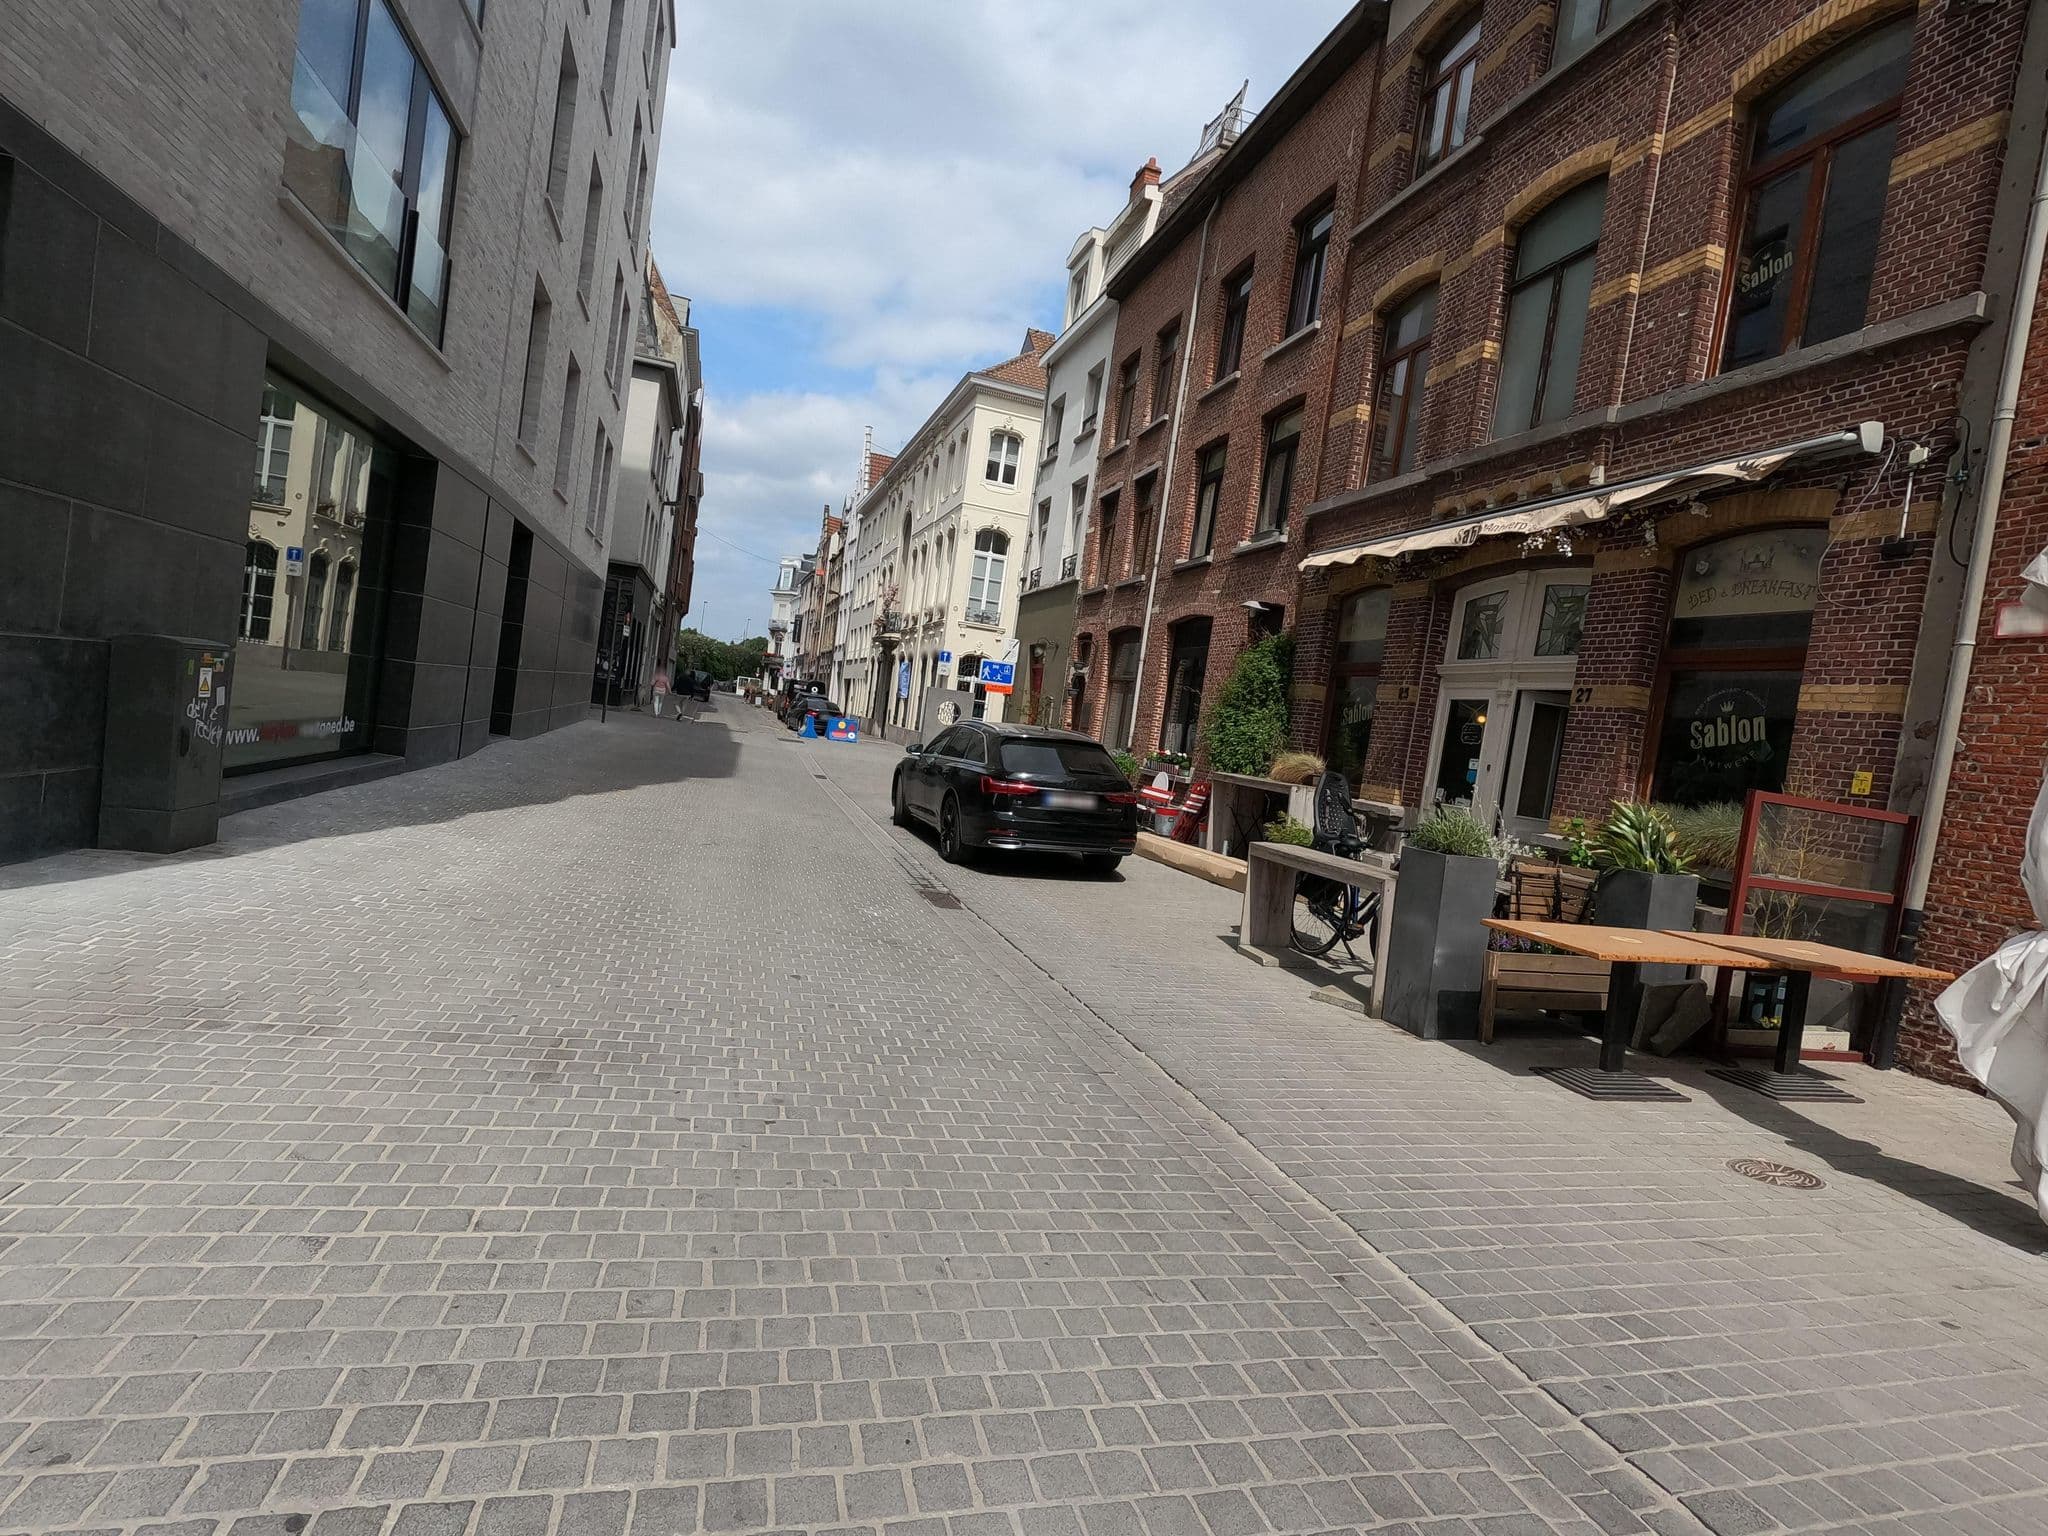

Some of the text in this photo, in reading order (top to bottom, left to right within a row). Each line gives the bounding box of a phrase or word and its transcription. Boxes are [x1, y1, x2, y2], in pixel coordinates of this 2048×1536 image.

[1741, 251, 1793, 293] Sablon
[1575, 687, 1593, 703] 27
[1690, 714, 1767, 750] Sablon
